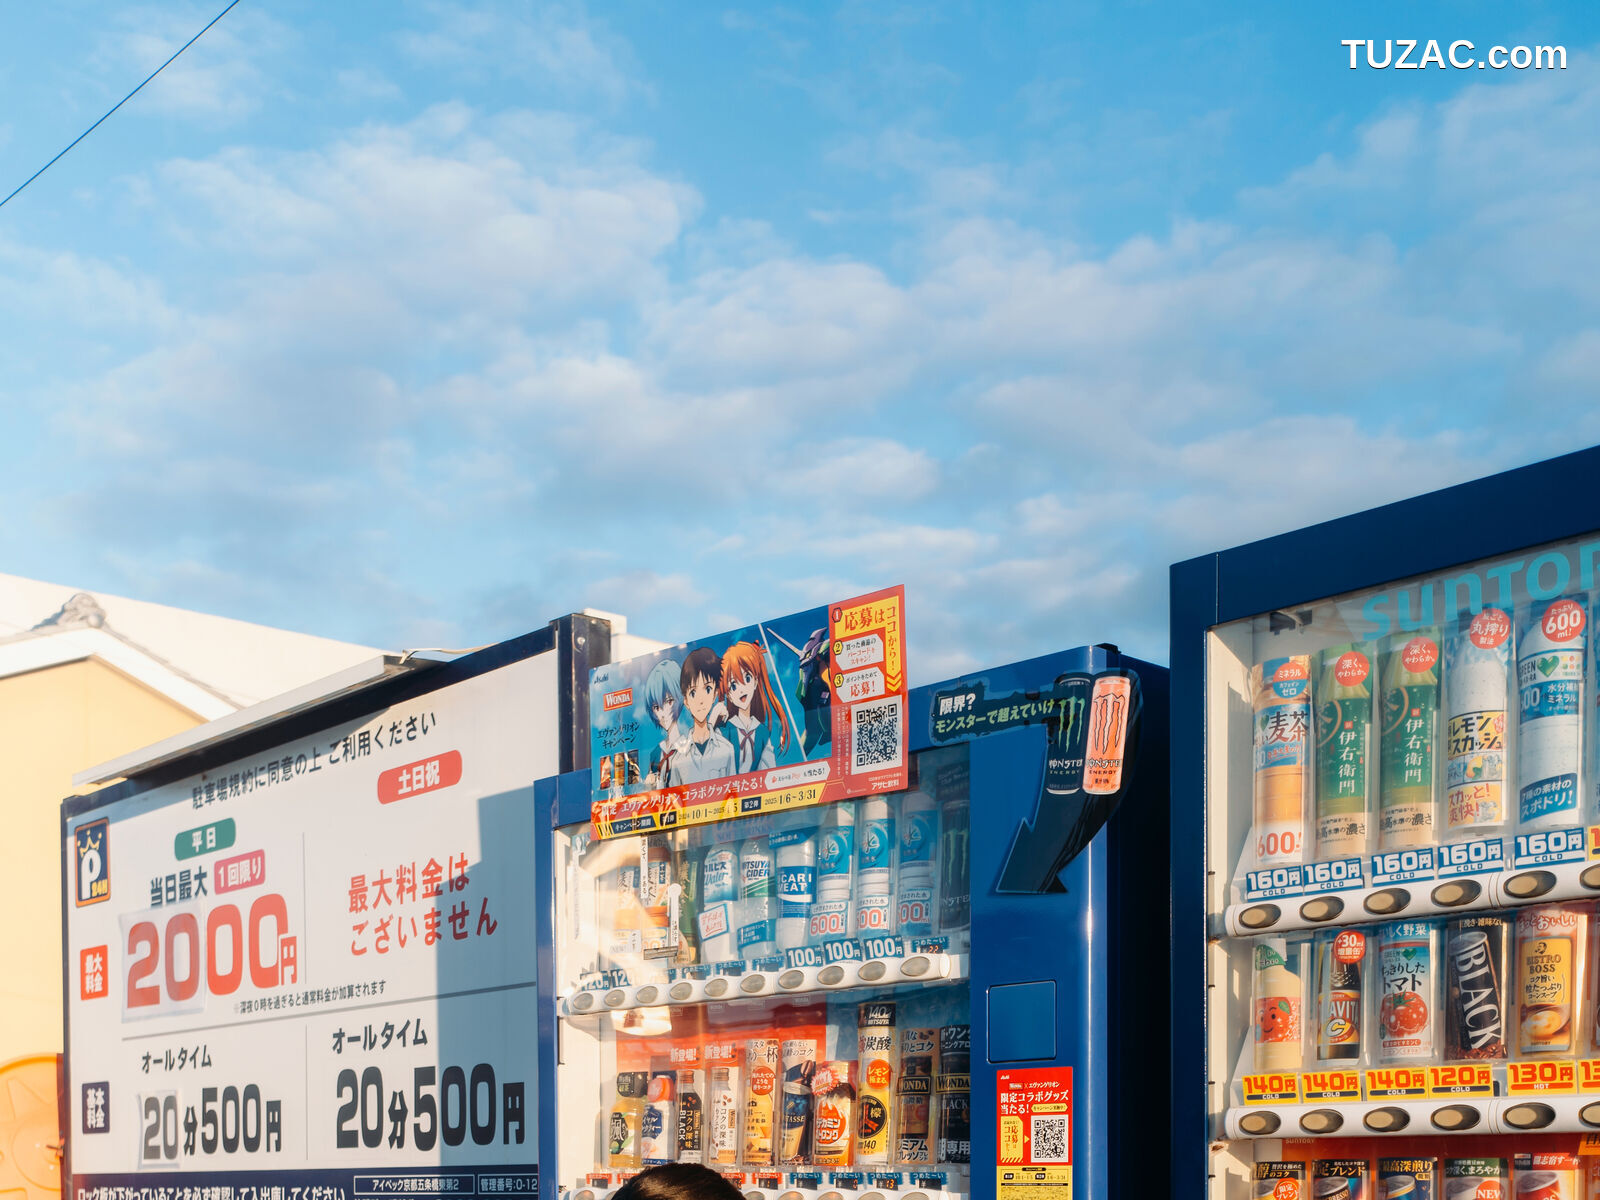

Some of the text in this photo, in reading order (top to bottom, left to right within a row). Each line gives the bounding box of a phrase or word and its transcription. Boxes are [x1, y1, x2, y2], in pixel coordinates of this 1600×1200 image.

[844, 606, 884, 632] 応募は
[1471, 621, 1509, 637] 丸搾り
[1545, 610, 1581, 635] 600
[1479, 637, 1494, 645] 製法
[1557, 629, 1572, 639] ml!
[1405, 653, 1436, 666] やわらか。
[1277, 669, 1302, 679] ミネラル
[1337, 667, 1367, 678] やわらか。
[850, 680, 876, 698] 応募!
[1282, 687, 1297, 696] ゼロ
[1547, 693, 1577, 704] ミネラル
[939, 693, 976, 715] 限界?
[935, 699, 1055, 733] モンスターで超えていけ
[1268, 711, 1309, 744] 麦茶
[1403, 716, 1424, 782] 伊右衛門
[192, 712, 436, 810] 駐車場規約に同意の上 ご利用ください
[1338, 731, 1357, 793] 伊右衛門
[397, 764, 440, 796] 土日祝
[871, 780, 900, 792] アサヒ飲料
[1449, 783, 1490, 806] スカッと!
[1449, 802, 1480, 824] 爽快!
[191, 826, 216, 850] 平日
[1517, 831, 1583, 856] 160円
[1373, 850, 1432, 875] 160円
[1439, 841, 1502, 865] 160円
[1534, 852, 1563, 862] COLD
[217, 855, 263, 889] 1回限り
[746, 869, 769, 878] CIDER
[1304, 860, 1360, 883] 160円
[1389, 872, 1415, 880] COLD
[1456, 863, 1483, 872] COLD
[150, 866, 208, 906] 当日最大
[348, 851, 469, 914] 最大料金は
[1247, 867, 1300, 891] 160円
[1320, 880, 1345, 889] COLD
[1262, 888, 1286, 897] COLD
[351, 897, 498, 956] ございません
[127, 892, 298, 1009] 2000円
[788, 947, 822, 967] 100円
[826, 940, 861, 961] 100円
[866, 937, 902, 958] 100円
[85, 952, 103, 974] 最大
[1527, 954, 1561, 965] BISTRO
[1529, 964, 1556, 974] BOSS
[85, 973, 103, 994] 料金
[1383, 974, 1422, 994] トマト
[1455, 943, 1502, 1050] BLACK
[1527, 991, 1557, 1000] コーンスープ
[332, 1018, 429, 1055] オールタイム
[141, 1045, 213, 1074] オールタイム
[670, 1047, 697, 1062] 新登場!
[705, 1045, 732, 1060] 新登場!
[868, 1066, 889, 1076] レモン
[1367, 1070, 1425, 1089] 140円
[1430, 1067, 1490, 1086] 120円
[1509, 1063, 1574, 1083] 130円
[1244, 1075, 1296, 1093] 140円
[1303, 1073, 1358, 1091] 140円
[86, 1087, 105, 1107] 基本
[1001, 1090, 1069, 1103] 限定コラボグッズ
[336, 1062, 526, 1152] 20分500円
[1001, 1103, 1030, 1115] 当たる!
[86, 1106, 105, 1129] 料金
[143, 1083, 282, 1161] 20分500円
[1477, 1189, 1504, 1199] NEW
